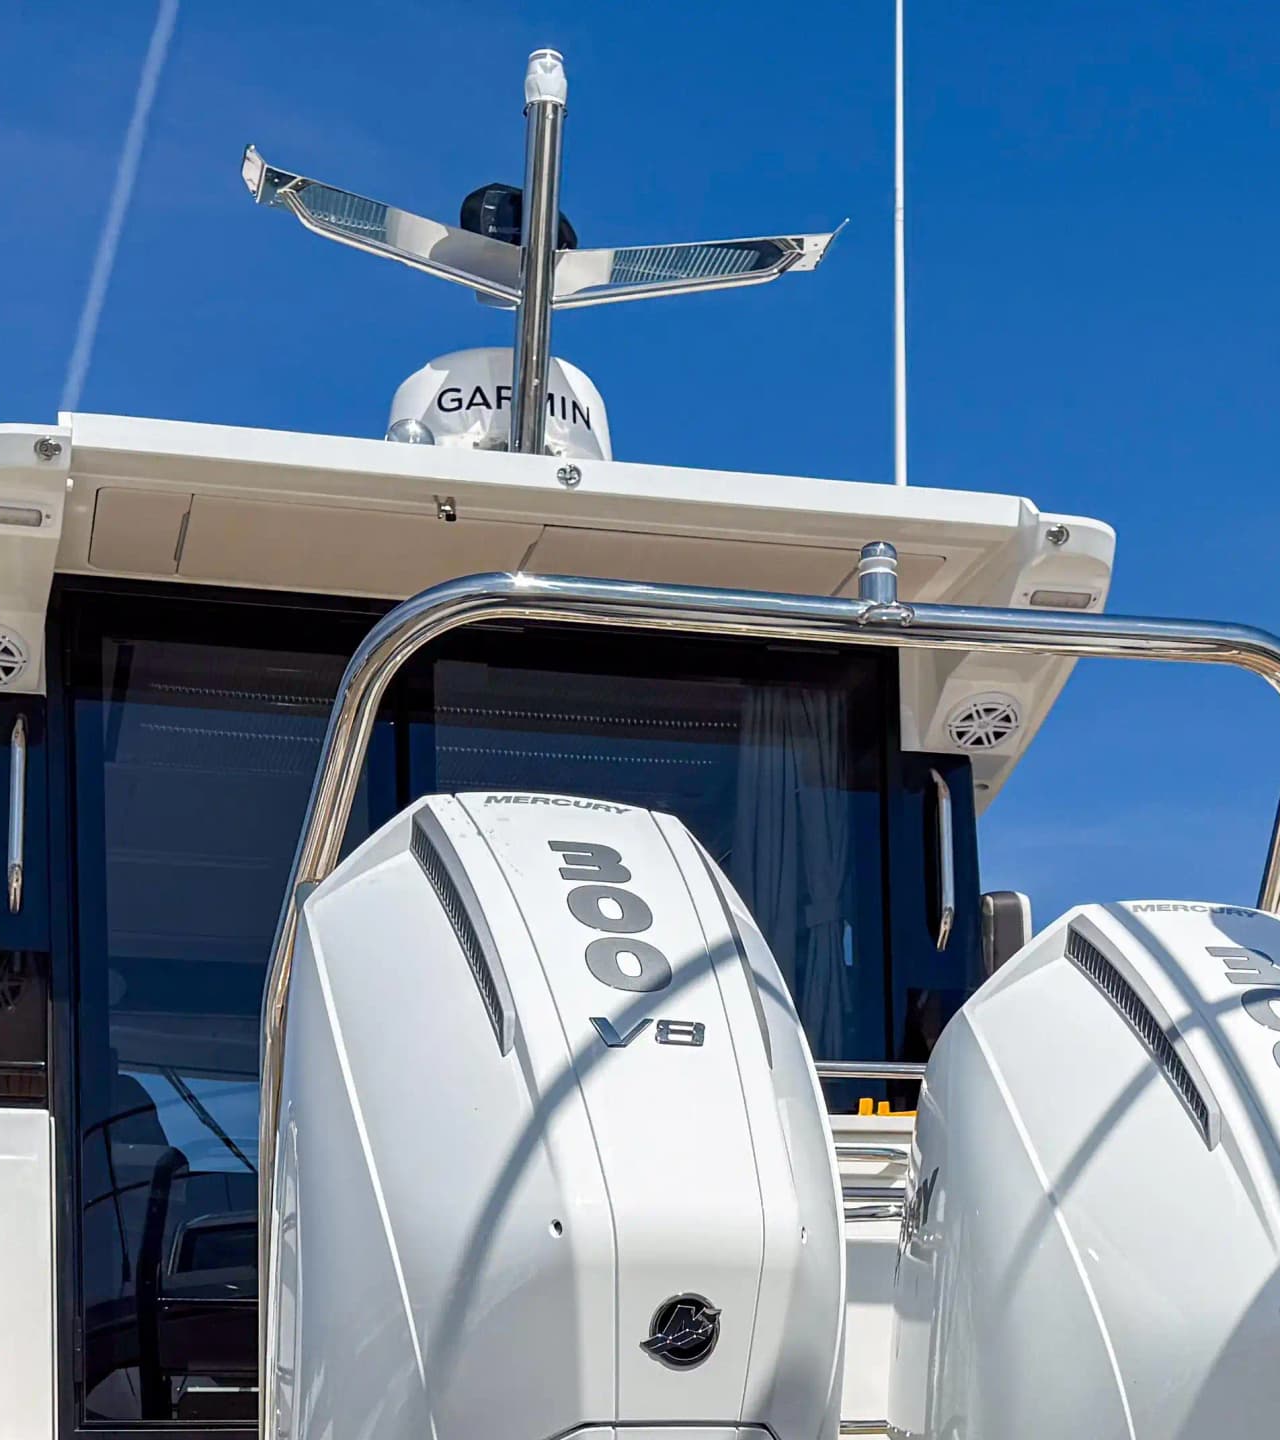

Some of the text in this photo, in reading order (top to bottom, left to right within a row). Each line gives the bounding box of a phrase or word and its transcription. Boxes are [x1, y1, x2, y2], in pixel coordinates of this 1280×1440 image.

[484, 794, 633, 815] MERCURY
[547, 840, 673, 993] 300
[1132, 903, 1258, 919] MERCURY
[588, 1016, 707, 1049] V8
